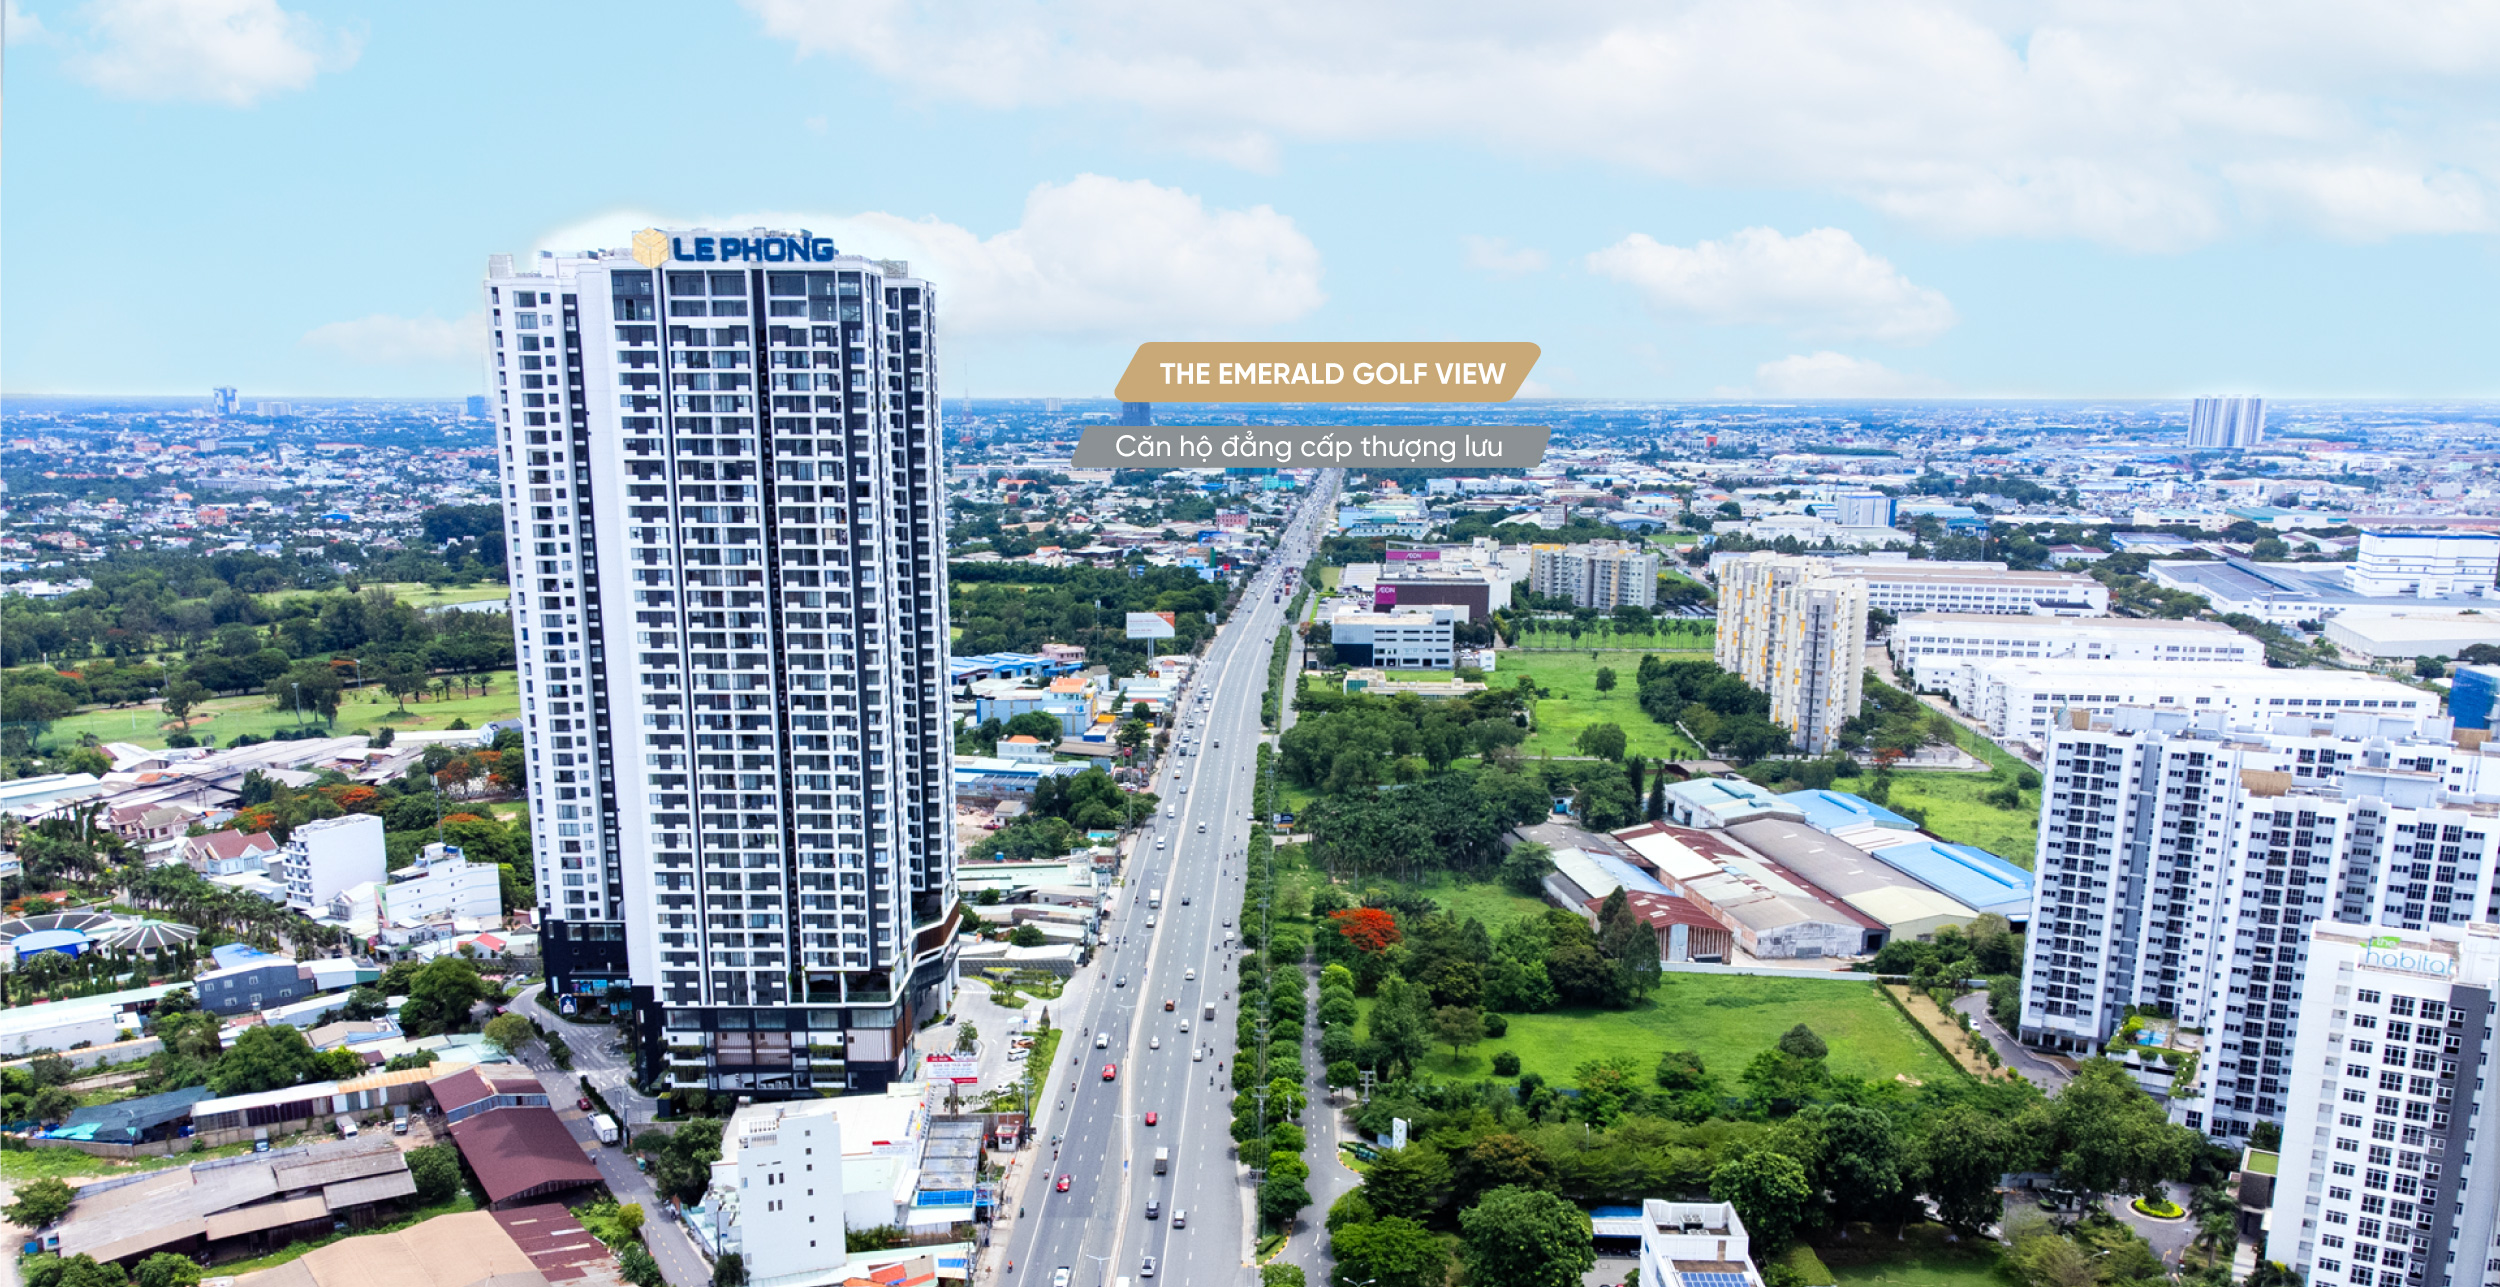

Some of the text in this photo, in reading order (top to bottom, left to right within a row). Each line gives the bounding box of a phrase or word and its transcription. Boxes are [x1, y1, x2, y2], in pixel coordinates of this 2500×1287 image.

[673, 237, 834, 262] LE PHONG
[2376, 936, 2397, 947] the
